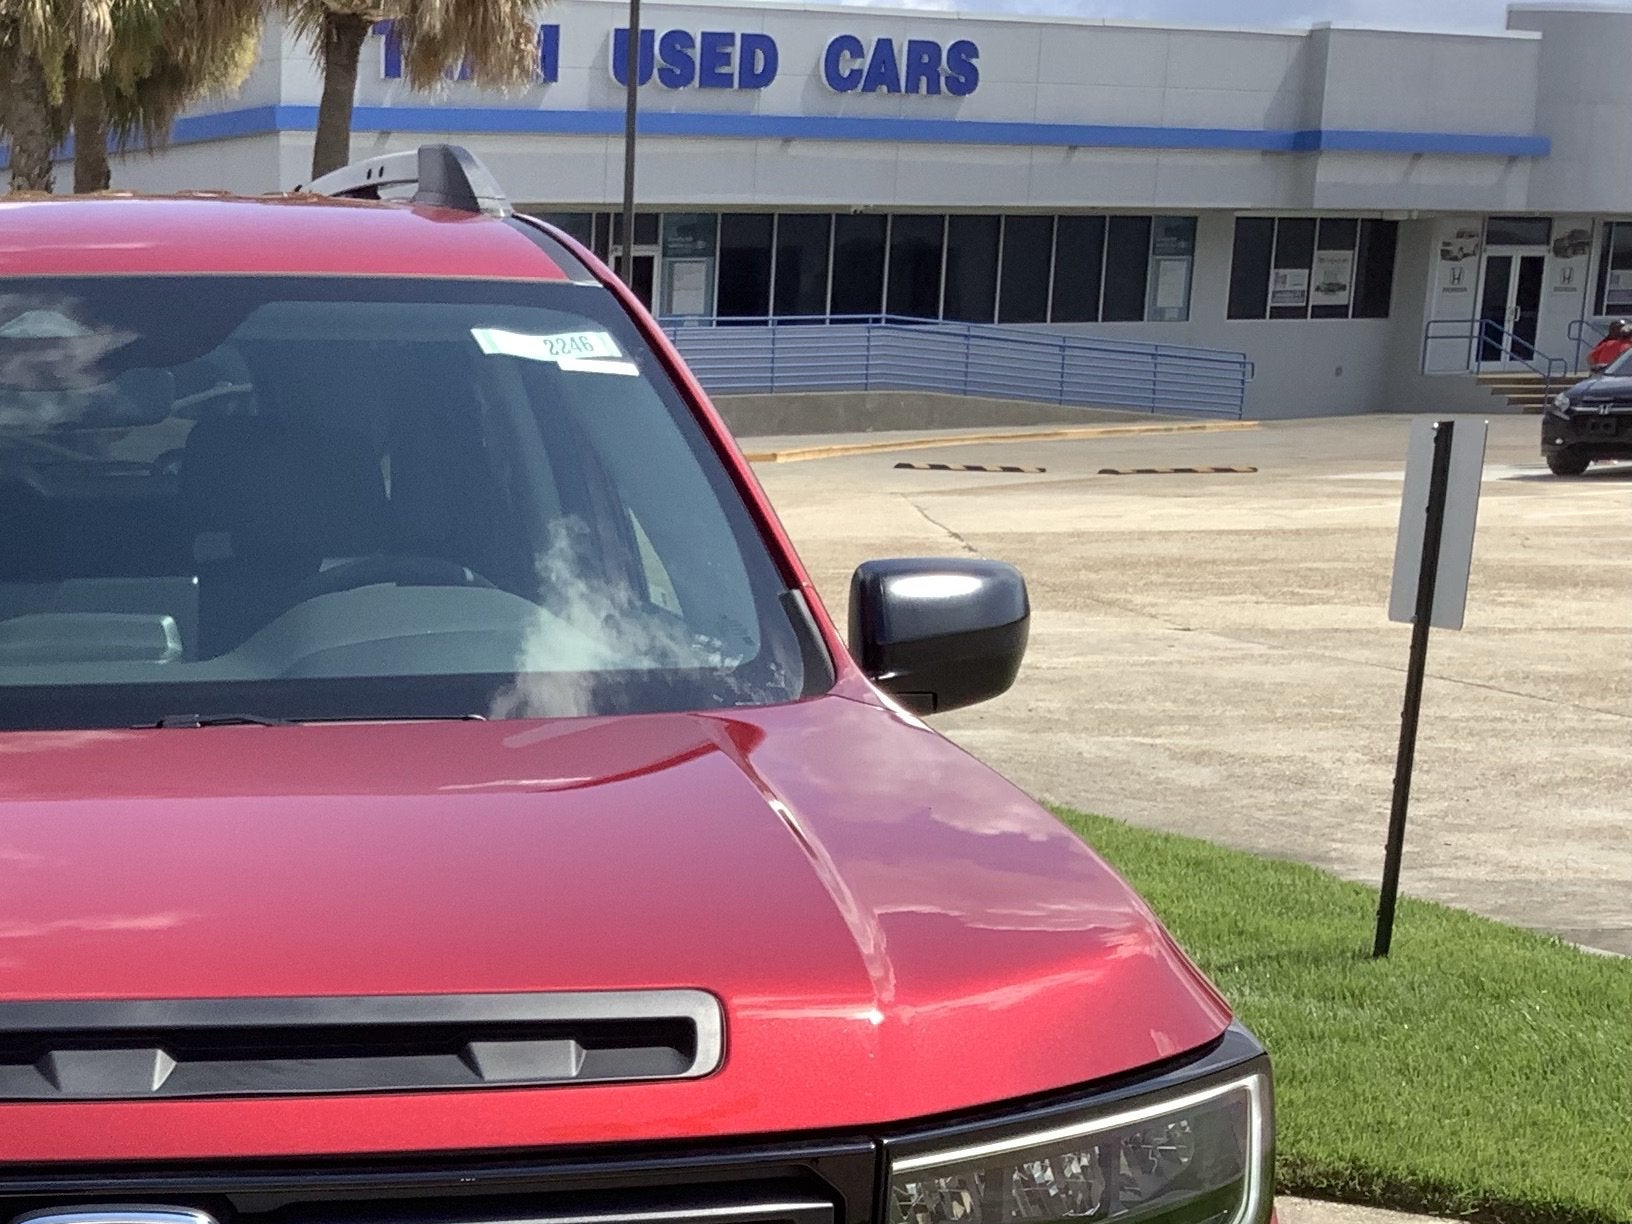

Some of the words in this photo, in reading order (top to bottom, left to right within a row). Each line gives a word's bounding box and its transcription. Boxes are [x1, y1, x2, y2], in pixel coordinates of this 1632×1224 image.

[612, 27, 779, 90] USED
[824, 34, 980, 97] CARS
[542, 335, 594, 356] 2246
